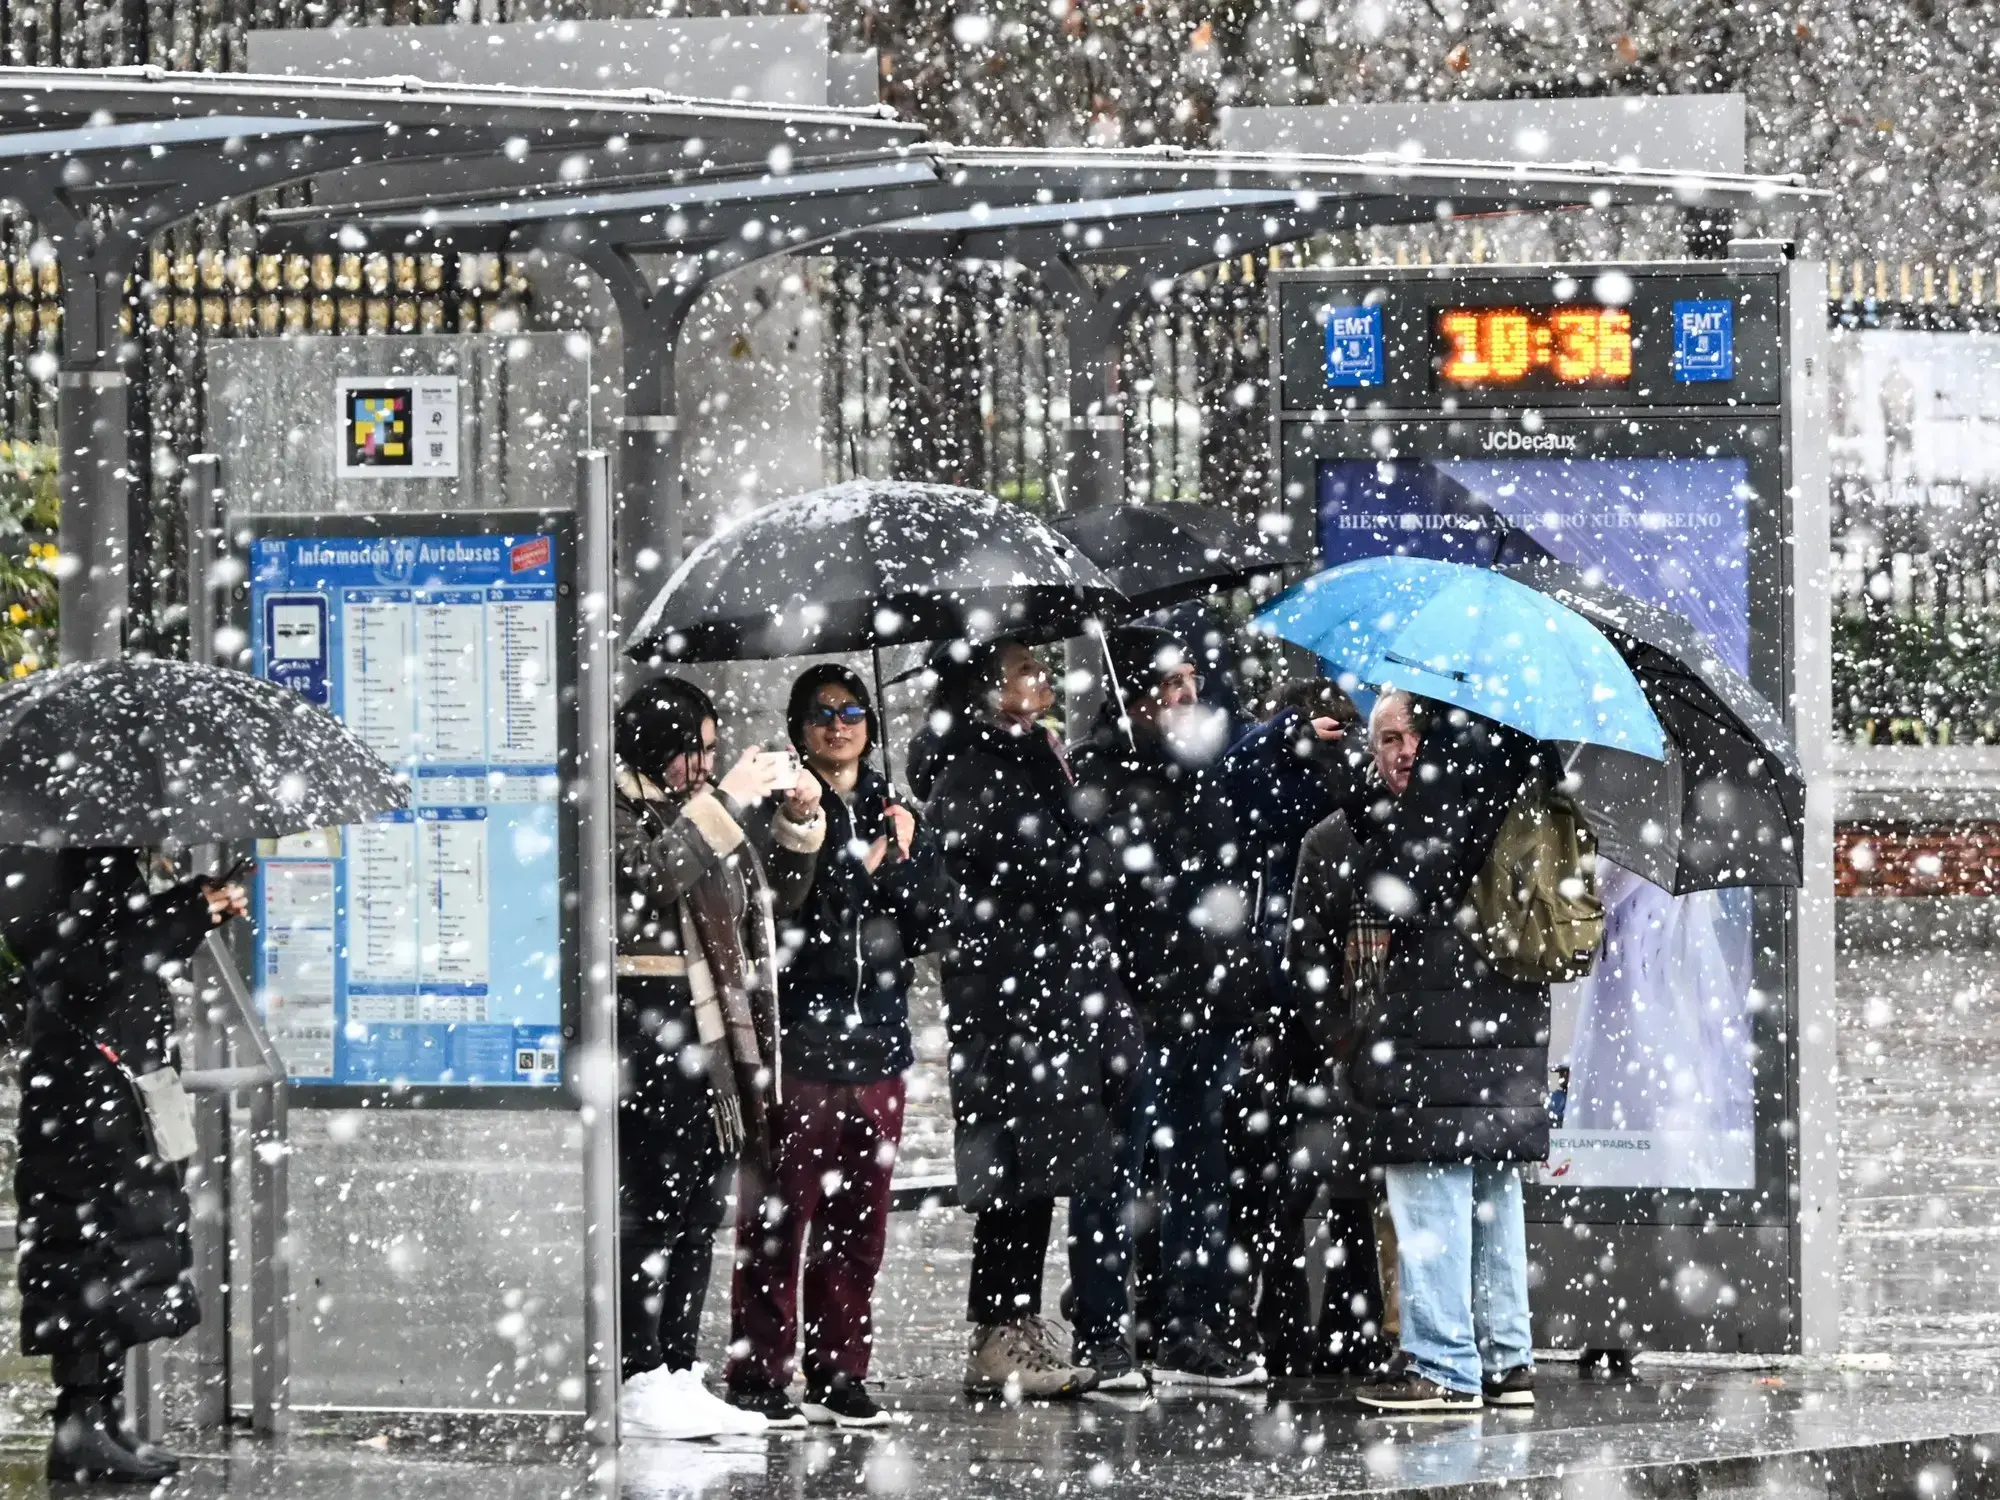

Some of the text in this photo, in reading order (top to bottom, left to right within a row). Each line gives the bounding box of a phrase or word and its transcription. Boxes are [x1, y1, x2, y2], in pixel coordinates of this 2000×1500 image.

[1333, 316, 1371, 335] EMT
[1682, 312, 1723, 330] EMT
[1448, 314, 1632, 377] 10:36
[1482, 430, 1576, 450] JCDecaux
[1494, 513, 1585, 529] NUESRO
[1591, 513, 1658, 529] NUEV
[395, 543, 413, 563] de
[419, 540, 500, 563] Autobuses
[1550, 1138, 1651, 1150] NEYLANDPARIS.ES
